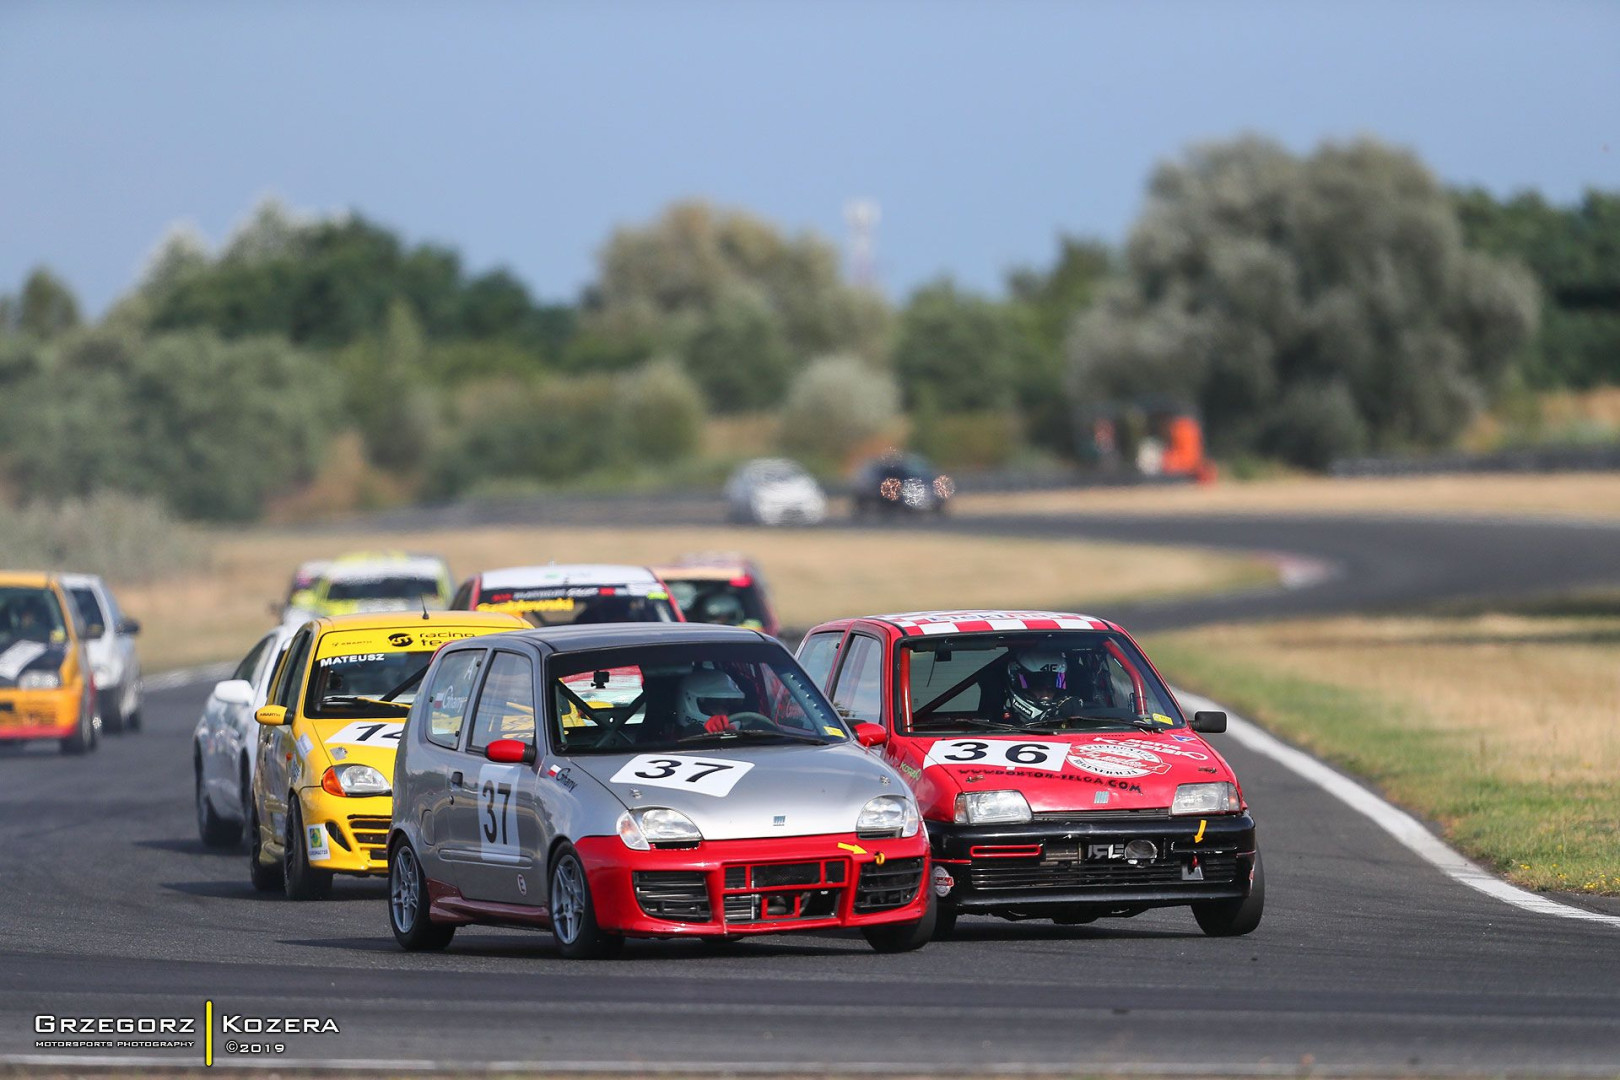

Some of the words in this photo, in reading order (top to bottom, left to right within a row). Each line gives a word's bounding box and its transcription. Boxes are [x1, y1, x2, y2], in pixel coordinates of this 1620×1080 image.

[320, 653, 385, 667] MATEUSZ
[944, 742, 1050, 764] 36
[634, 760, 735, 783] 37
[482, 780, 512, 845] 37
